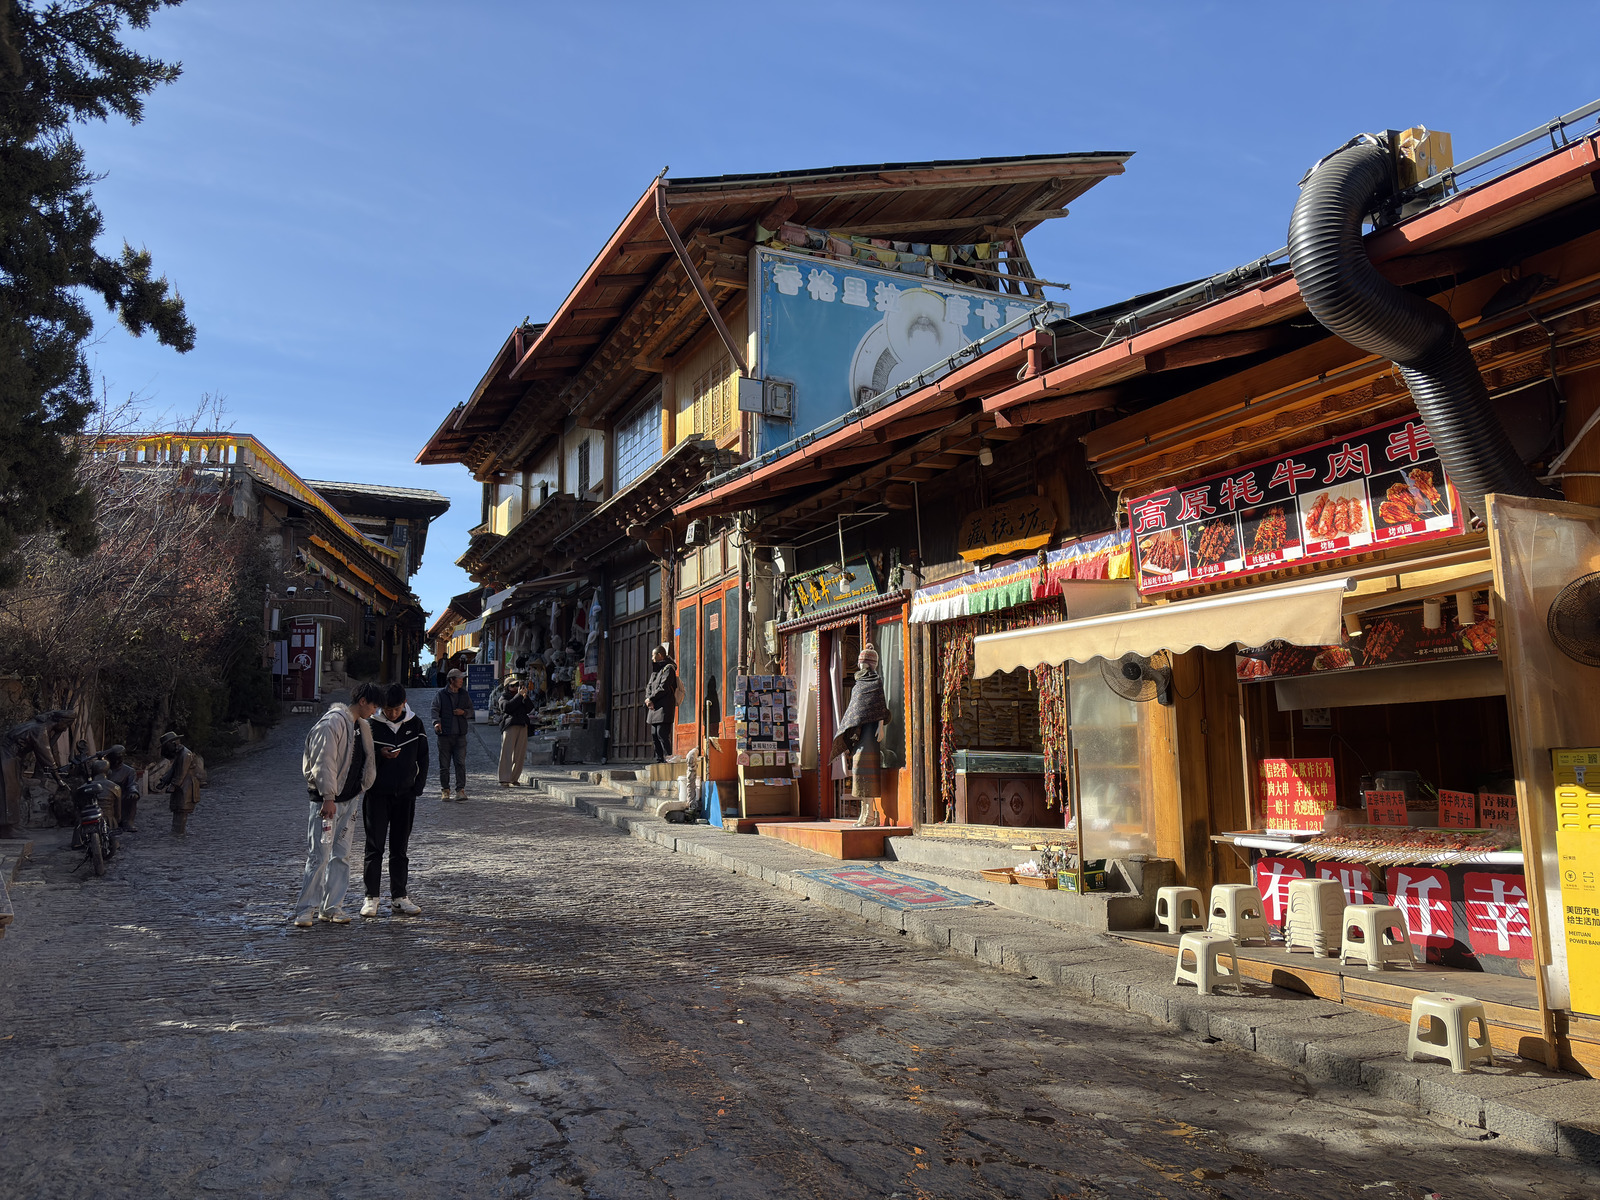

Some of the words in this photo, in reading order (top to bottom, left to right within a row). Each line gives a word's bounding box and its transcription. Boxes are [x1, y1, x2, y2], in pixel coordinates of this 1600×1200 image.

[772, 263, 901, 313] 香格里拉
[1133, 422, 1437, 534] 高原牦牛肉串
[1388, 523, 1413, 537] 烤鸡腿
[1320, 540, 1335, 551] 烤肠
[1252, 552, 1278, 565] 铁板鱿鱼
[1196, 564, 1220, 577] 烤羊肉串
[1143, 574, 1173, 587] 高原牦牛肉串
[1291, 761, 1332, 778] 无欺诈行为
[1261, 780, 1290, 797] 牛肉大串
[1295, 780, 1328, 797] 羊肉大串
[1367, 792, 1405, 807] 正宗羊肉大串
[1440, 793, 1474, 810] 牦牛肉大串
[1373, 808, 1402, 822] 假一赔十
[1444, 809, 1471, 827] 假一赔十
[1569, 930, 1592, 939] MEITUAN
[1569, 938, 1588, 946] POWER
